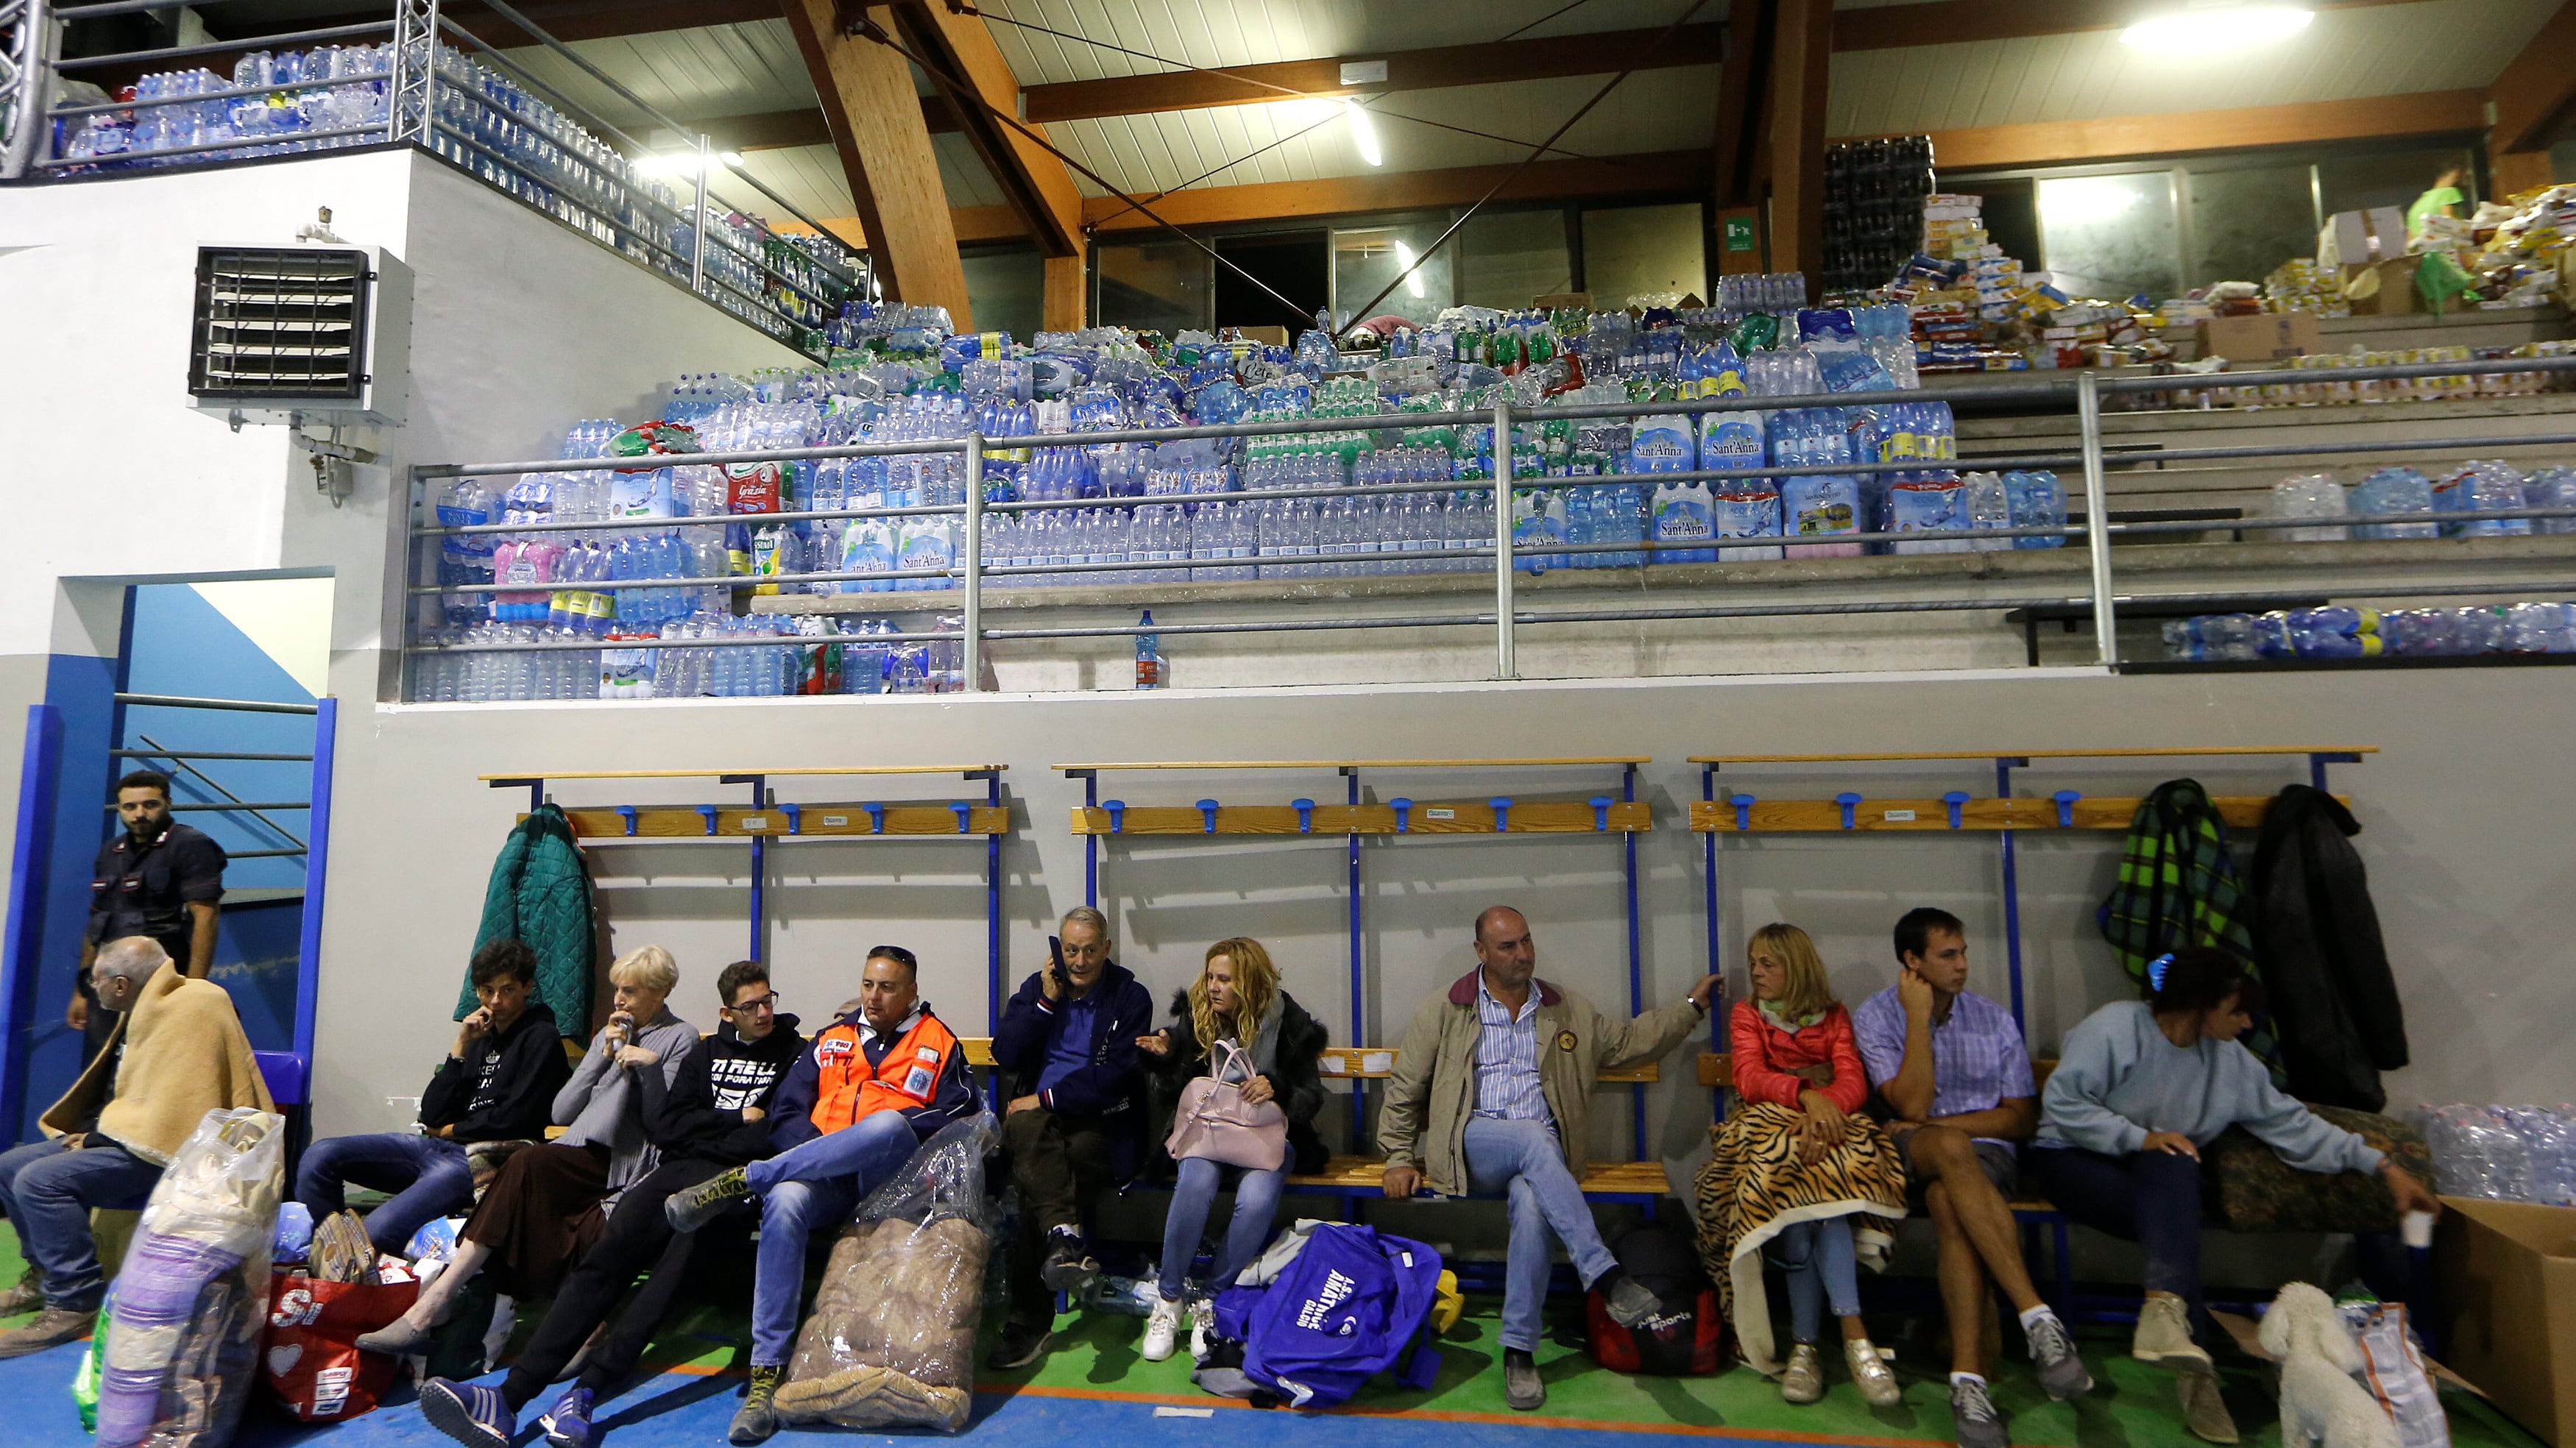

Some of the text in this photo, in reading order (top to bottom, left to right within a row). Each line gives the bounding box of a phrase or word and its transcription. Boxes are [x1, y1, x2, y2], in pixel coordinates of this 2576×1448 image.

[1636, 443, 1683, 457] Sant'Anna
[1712, 441, 1761, 454] Sant'Anna
[739, 485, 767, 500] Grazia
[1660, 520, 1709, 536] Sant'Anna
[849, 561, 887, 572] ant'Anna
[903, 554, 946, 569] Sant'Anna
[1296, 1299, 1317, 1327] CALCIO
